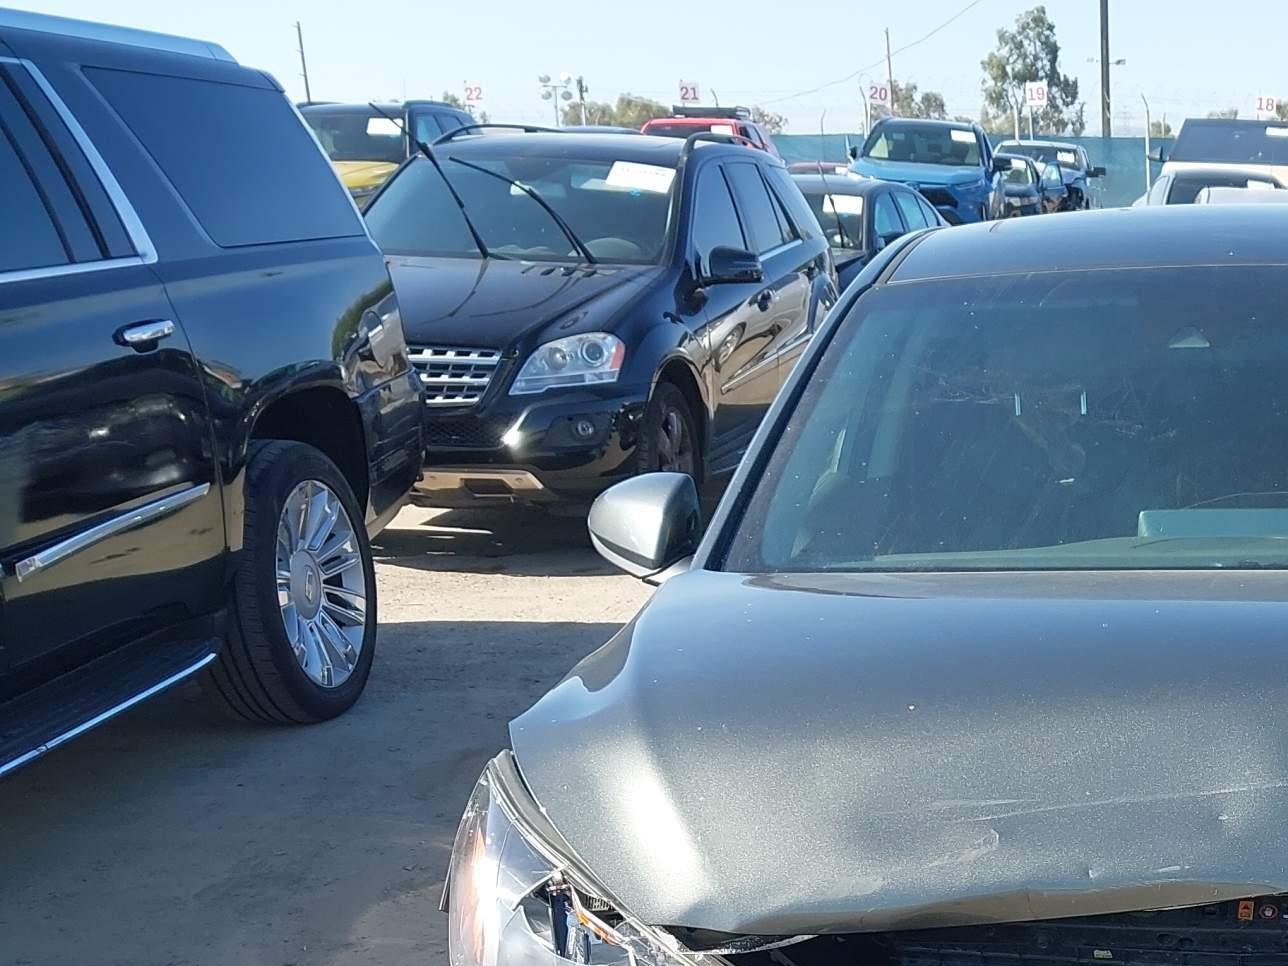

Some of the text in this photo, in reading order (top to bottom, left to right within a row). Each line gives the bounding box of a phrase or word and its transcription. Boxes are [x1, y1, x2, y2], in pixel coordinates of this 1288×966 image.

[464, 87, 482, 101] 22
[680, 87, 699, 101] 21
[869, 85, 888, 101] 20
[1027, 87, 1046, 101] 19
[1256, 97, 1275, 112] 18
